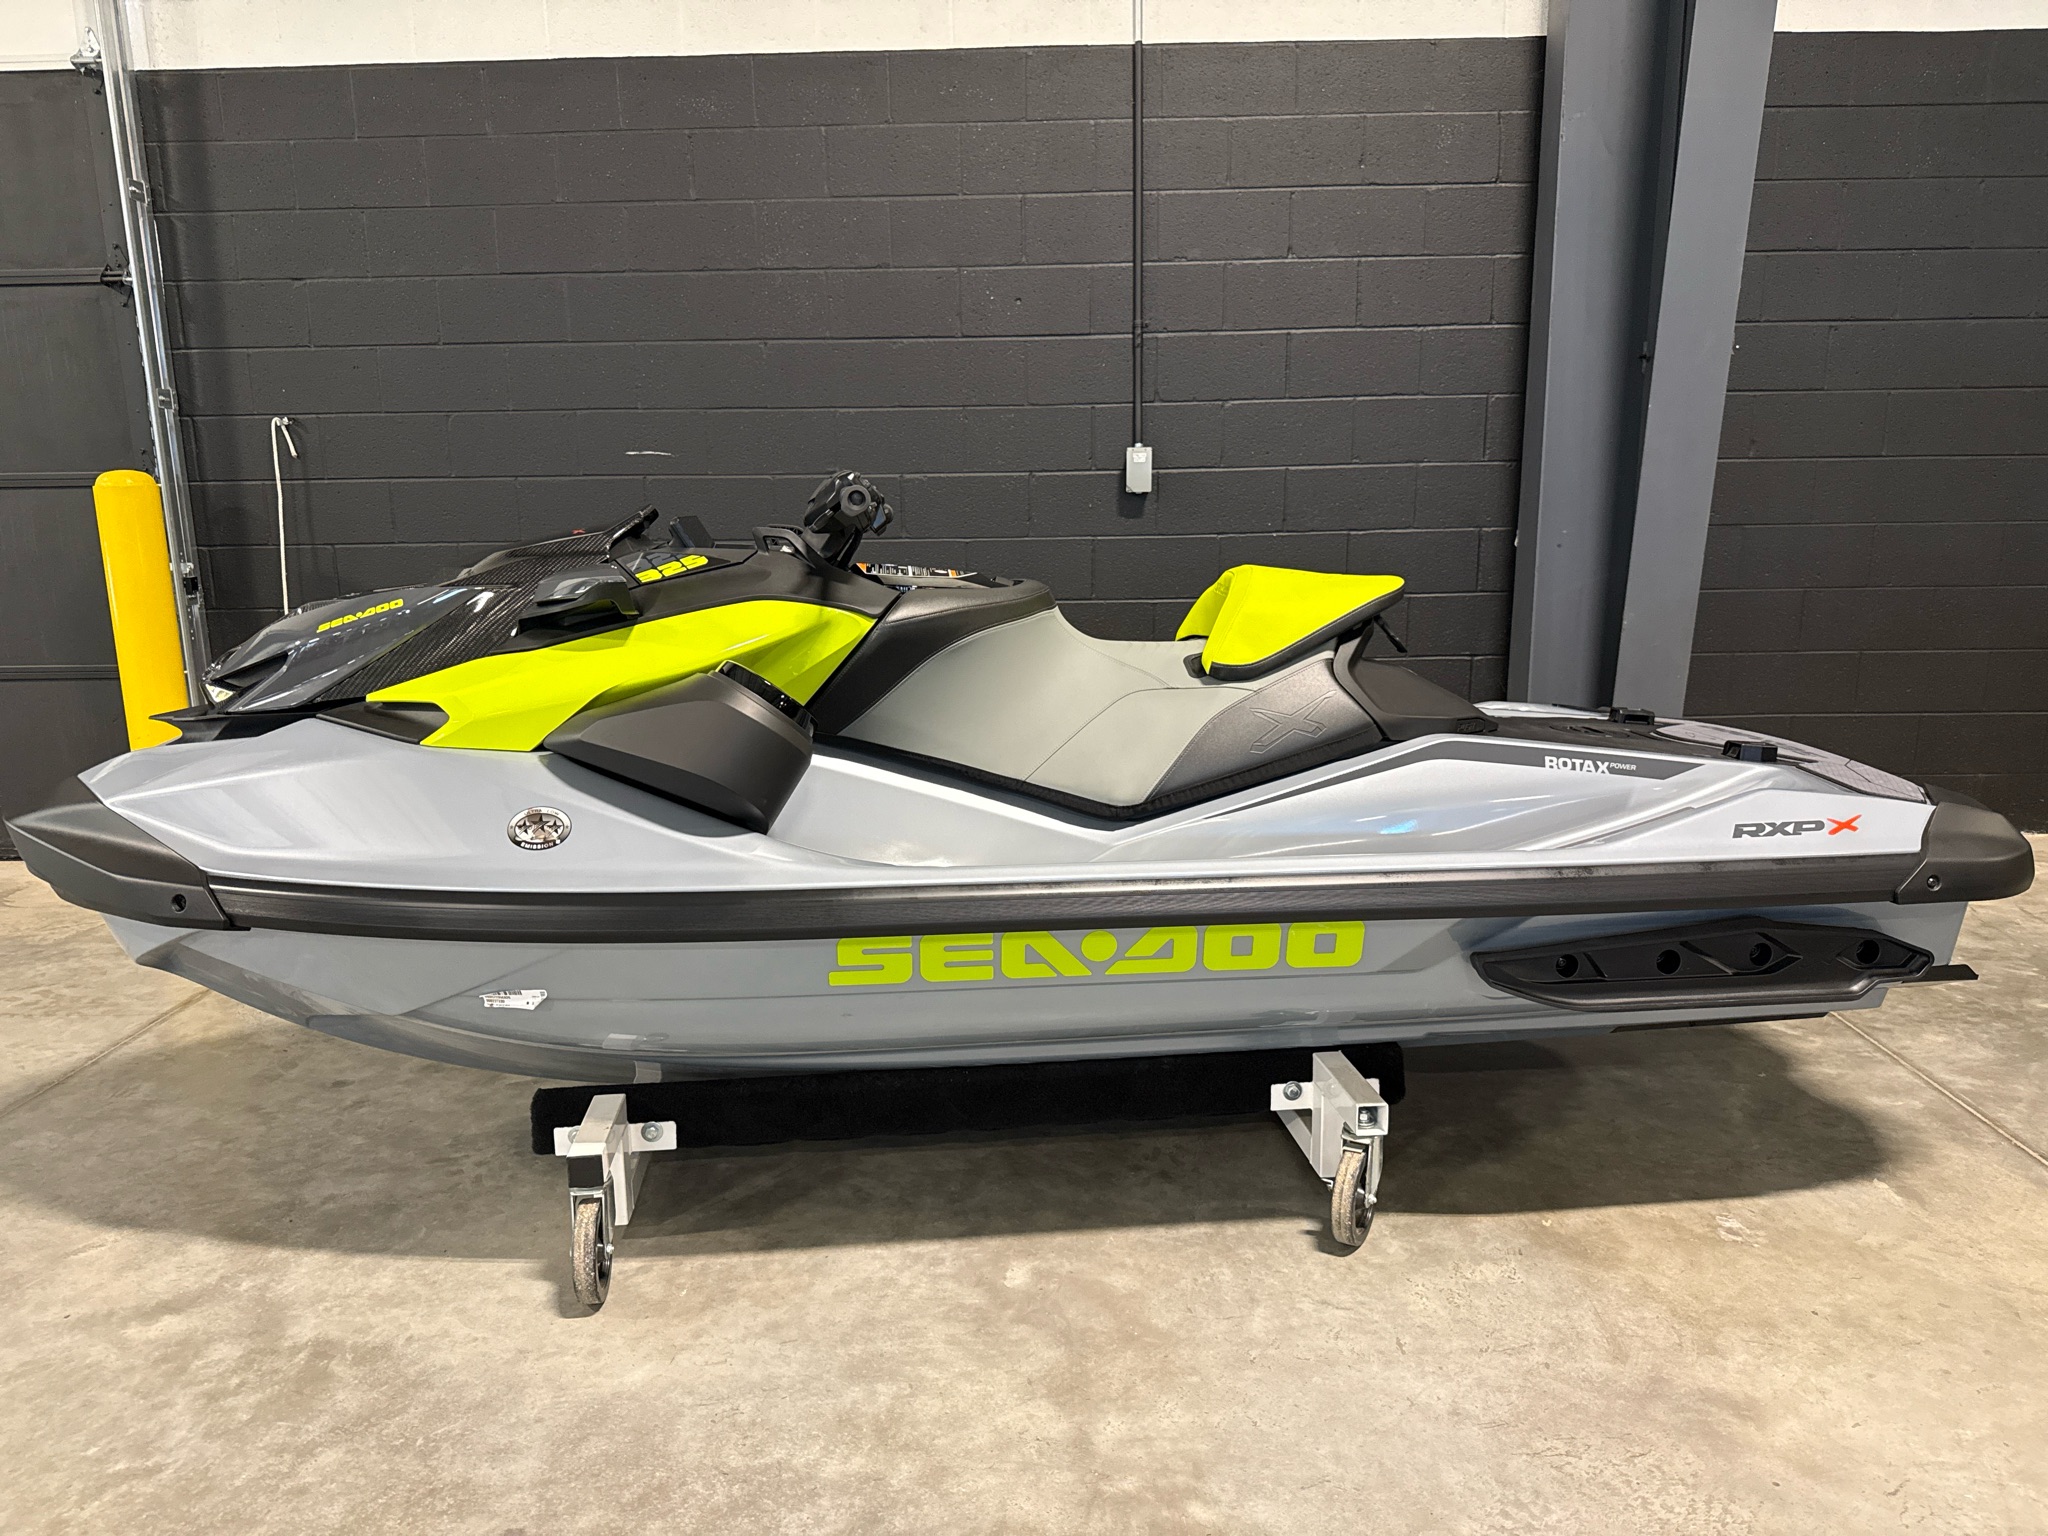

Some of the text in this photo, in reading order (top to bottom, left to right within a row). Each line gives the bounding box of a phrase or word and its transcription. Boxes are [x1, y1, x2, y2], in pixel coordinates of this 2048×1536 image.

[634, 554, 709, 583] 325
[1544, 755, 1637, 774] ROTAX POWER
[520, 841, 554, 849] EMISSION
